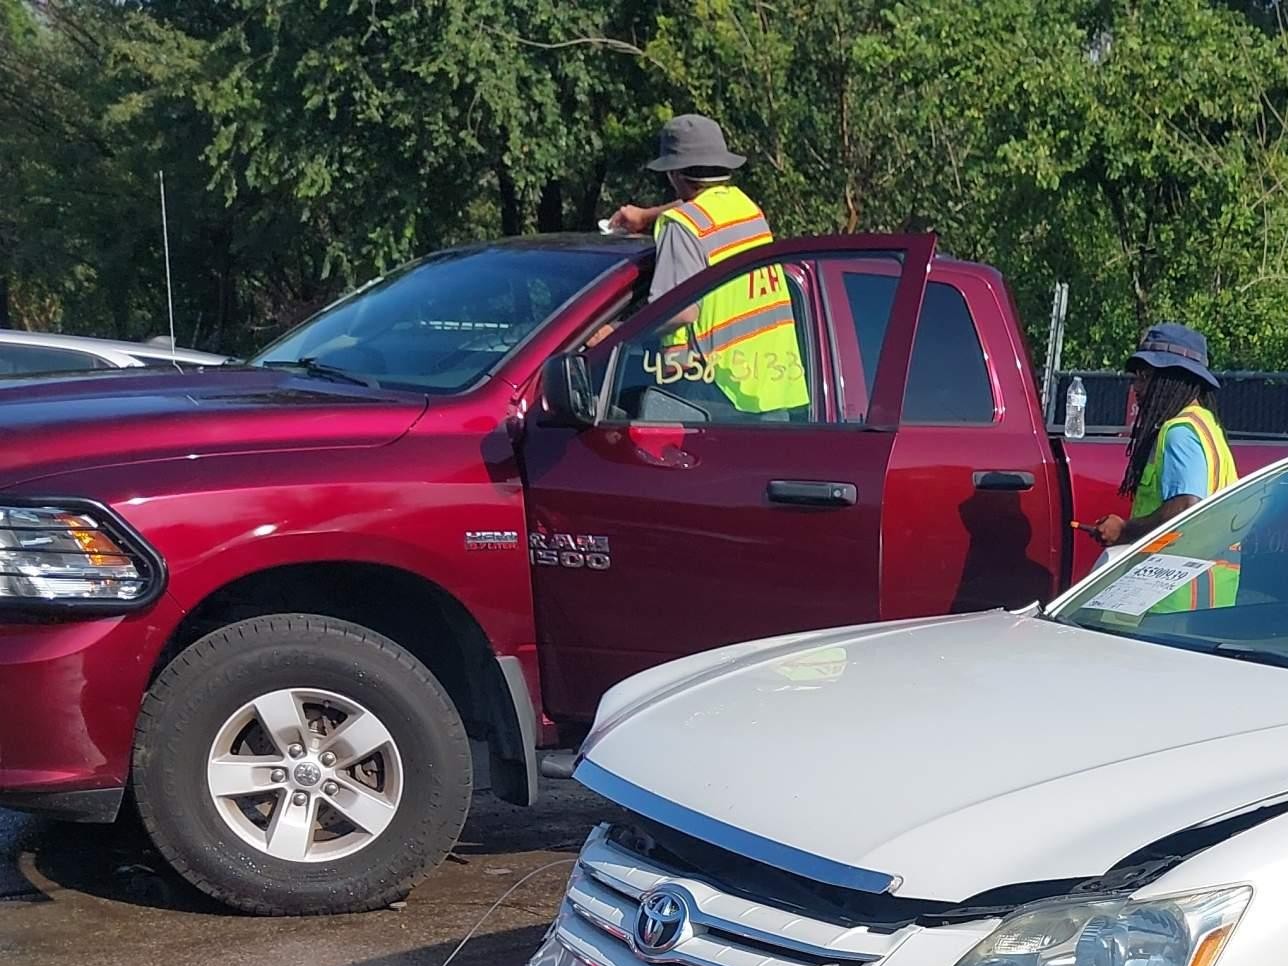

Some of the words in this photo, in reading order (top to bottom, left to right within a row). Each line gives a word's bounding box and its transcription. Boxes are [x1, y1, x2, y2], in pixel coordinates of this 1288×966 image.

[643, 350, 805, 385] 45585133
[529, 532, 610, 553] RAM
[530, 549, 611, 571] 1500
